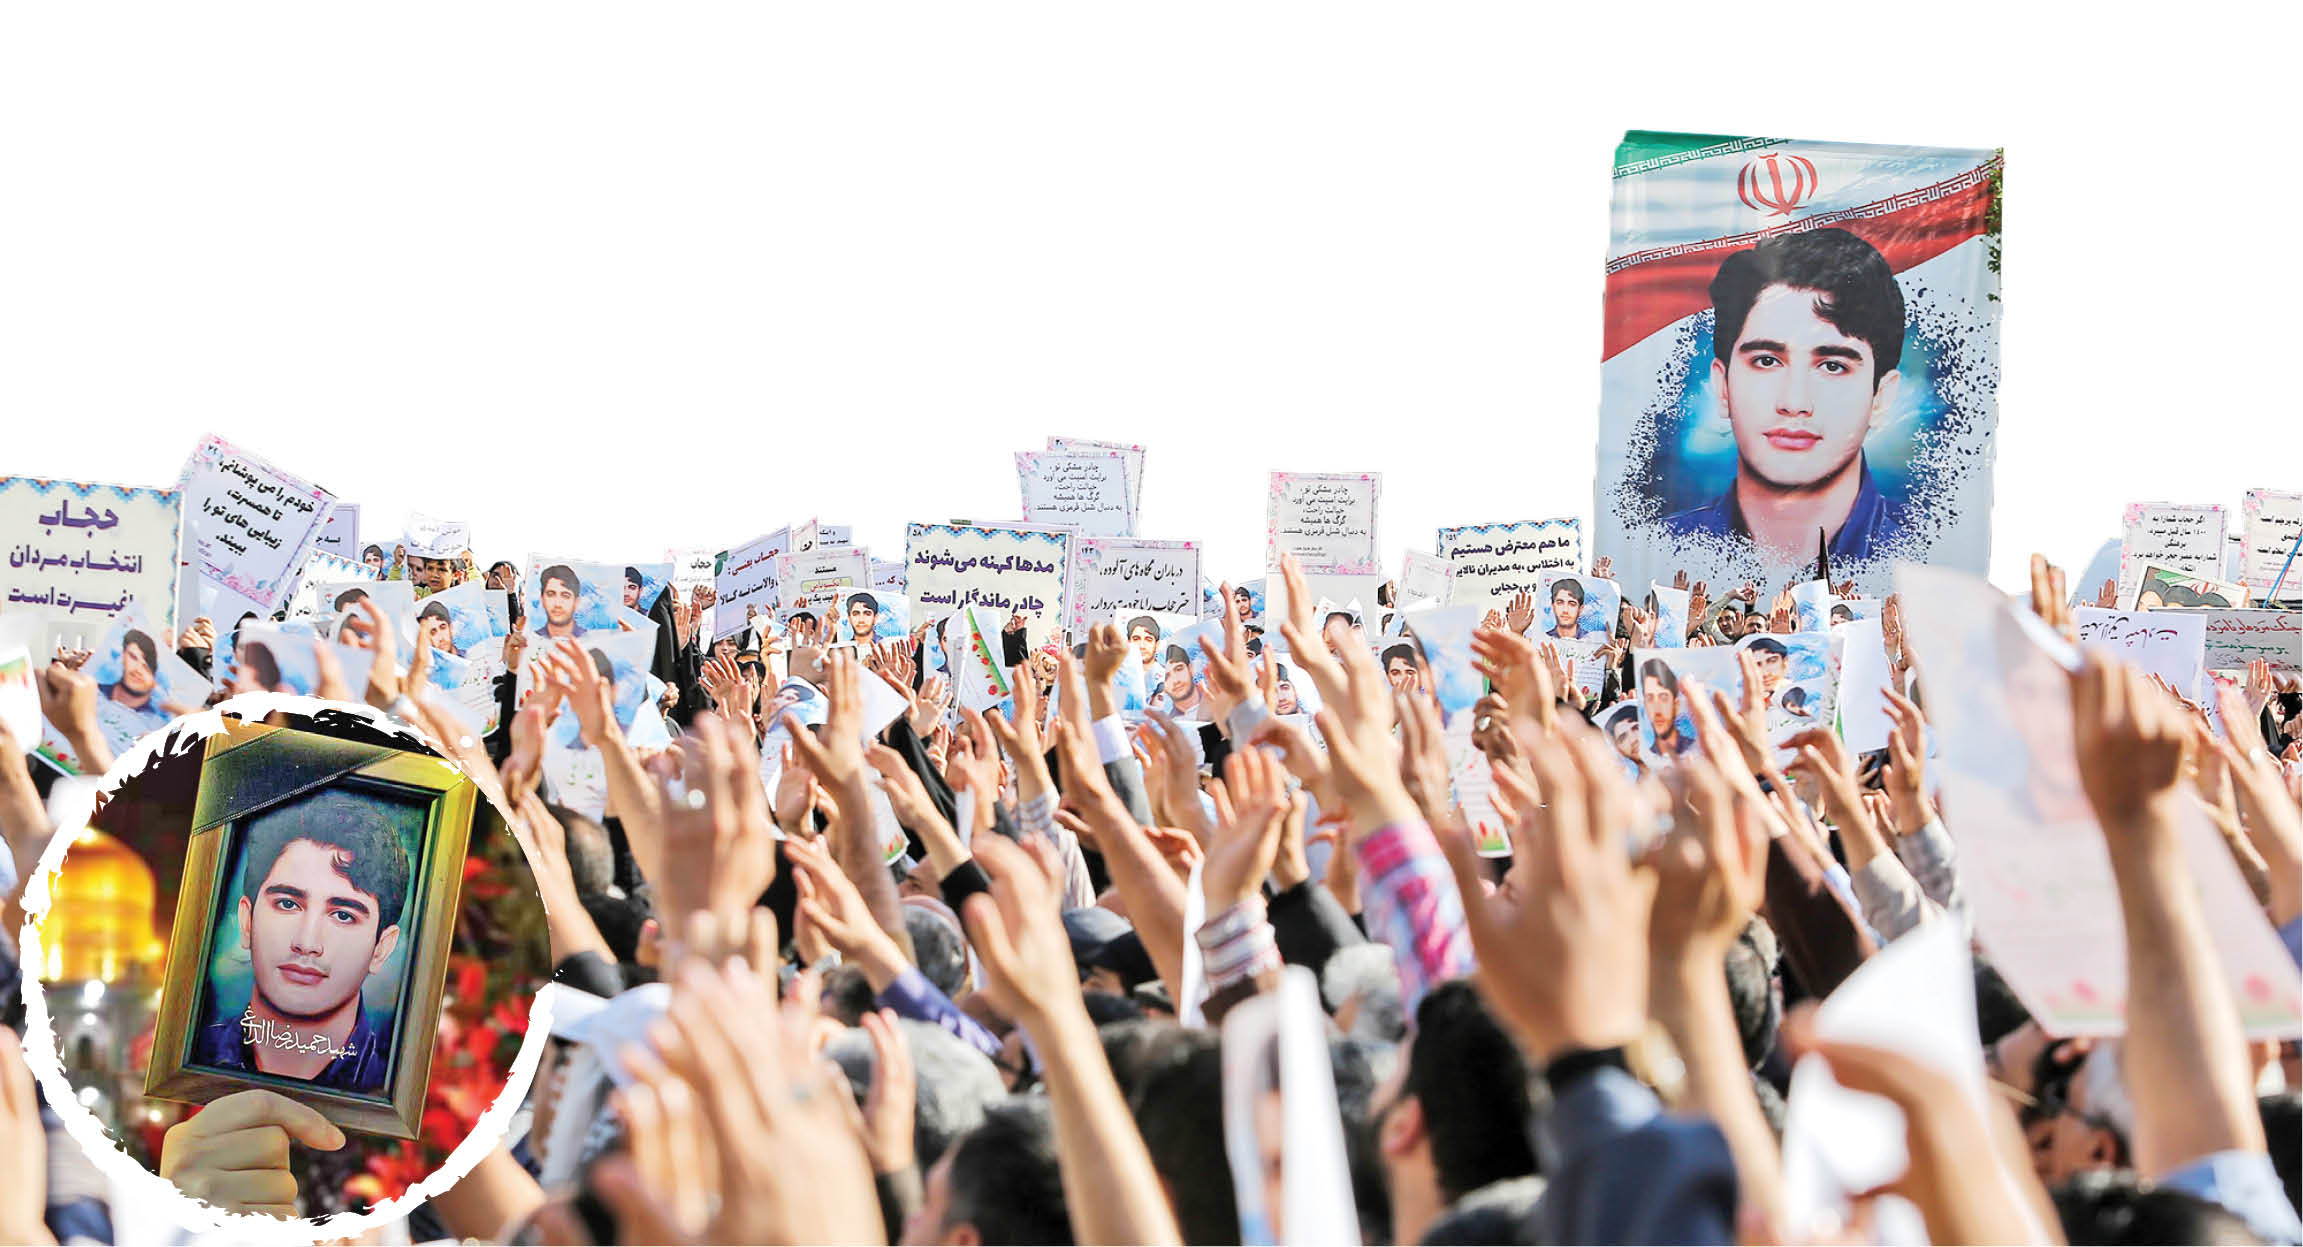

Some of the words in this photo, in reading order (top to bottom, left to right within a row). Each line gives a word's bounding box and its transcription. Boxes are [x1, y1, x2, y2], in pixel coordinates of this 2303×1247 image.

[257, 483, 277, 494] می
[276, 487, 284, 502] را
[202, 497, 211, 513] را
[210, 505, 227, 517] تو
[283, 497, 314, 513] خودم
[39, 499, 119, 538] حجاب
[224, 513, 249, 529] های
[272, 510, 283, 521] تا
[247, 528, 282, 550] زیبایی
[1538, 540, 1556, 554] هم
[1557, 536, 1570, 548] ما
[1450, 543, 1493, 561] هستیم
[1495, 539, 1537, 557] معترض
[9, 544, 68, 572] مردان
[69, 549, 143, 575] انتخاب
[979, 555, 1014, 575] کهنه
[1015, 556, 1055, 573] مدها
[1526, 557, 1563, 573] اختلاس
[1565, 560, 1575, 570] به
[1477, 563, 1510, 577] مدیران
[8, 586, 54, 606] است
[919, 589, 957, 605] است
[1011, 595, 1044, 619] چادر
[317, 1037, 358, 1060] شهید
